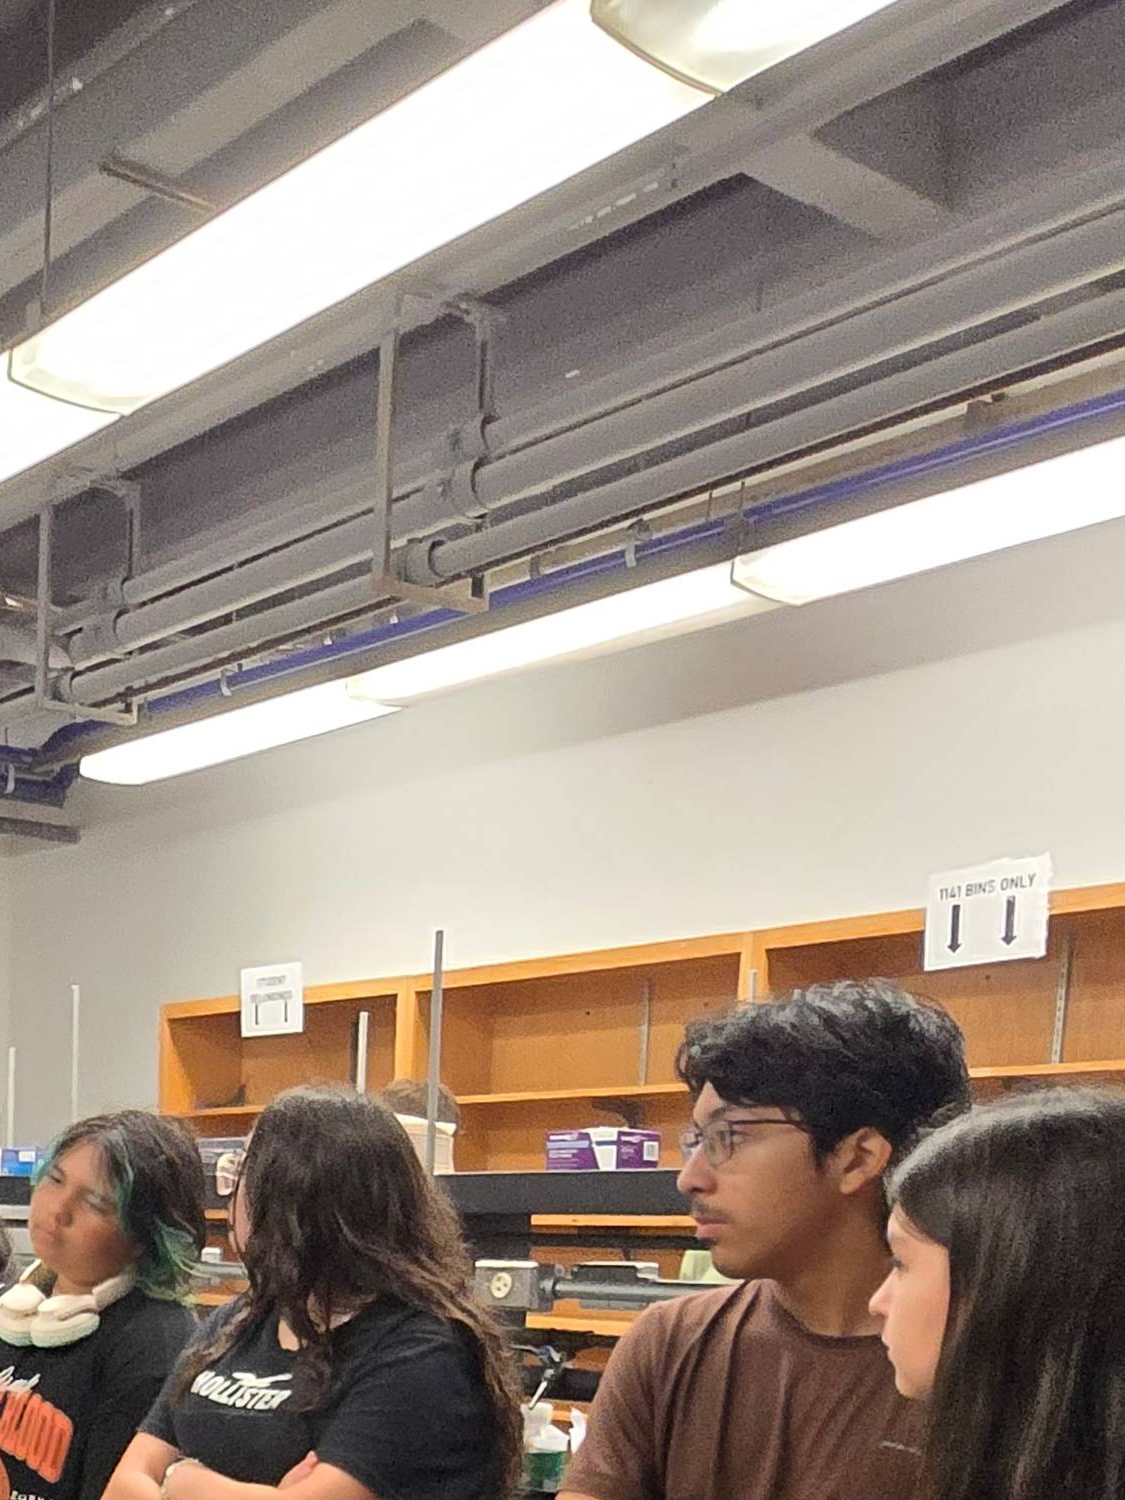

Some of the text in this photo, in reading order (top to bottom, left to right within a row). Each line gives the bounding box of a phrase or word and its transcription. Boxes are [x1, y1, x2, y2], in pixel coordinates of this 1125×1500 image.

[939, 873, 1037, 901] 1141 BINS ONLY
[190, 1371, 292, 1410] HOLLISTER
